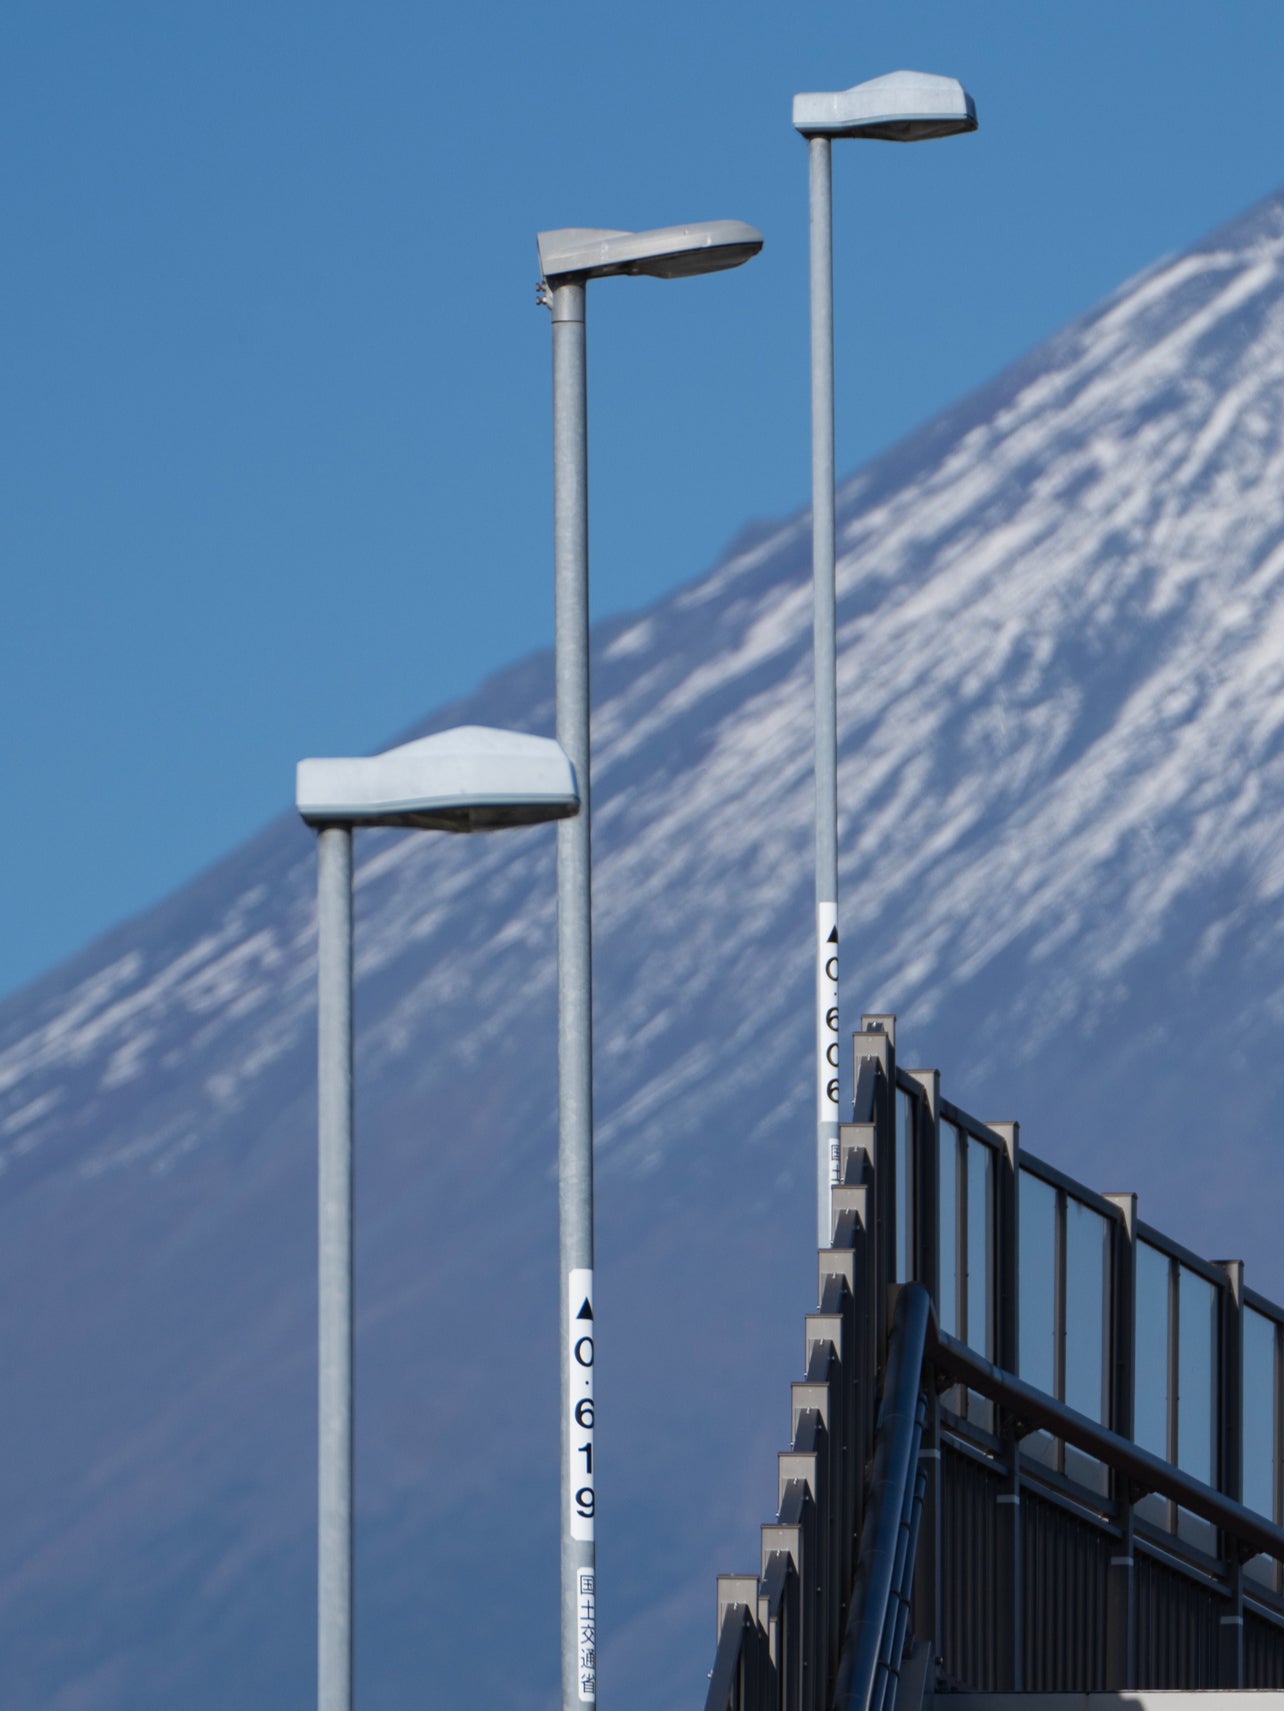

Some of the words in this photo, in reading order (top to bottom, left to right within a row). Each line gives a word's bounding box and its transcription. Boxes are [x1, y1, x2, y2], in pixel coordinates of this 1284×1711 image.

[574, 1336, 595, 1518] 0.619
[580, 1575, 595, 1694] 国土交通省
